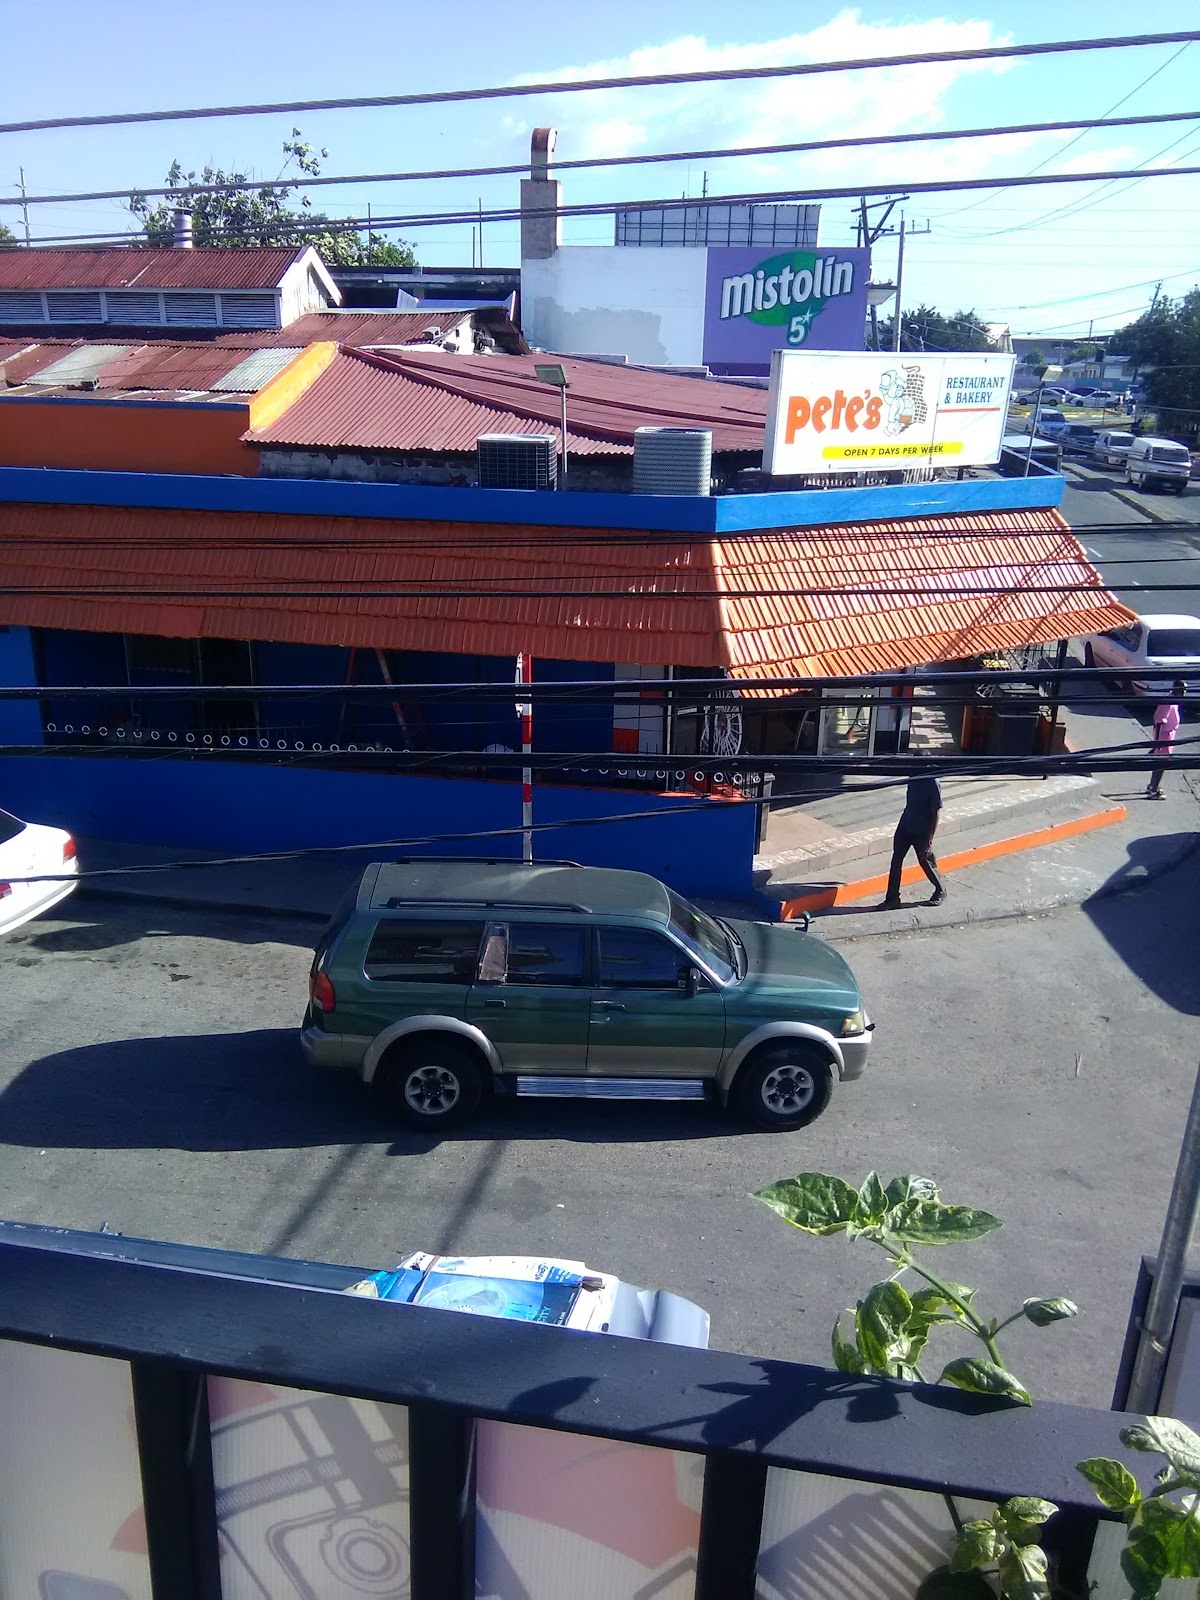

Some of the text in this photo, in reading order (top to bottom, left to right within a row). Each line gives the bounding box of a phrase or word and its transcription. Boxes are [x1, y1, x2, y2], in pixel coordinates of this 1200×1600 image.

[720, 256, 853, 319] mistolín
[788, 316, 806, 343] 5
[946, 376, 1005, 390] RESTAURANT
[944, 391, 993, 404] & BAKERY
[785, 389, 883, 444] pete's
[844, 445, 944, 457] OPEN 7 DAYS PER WEEK
